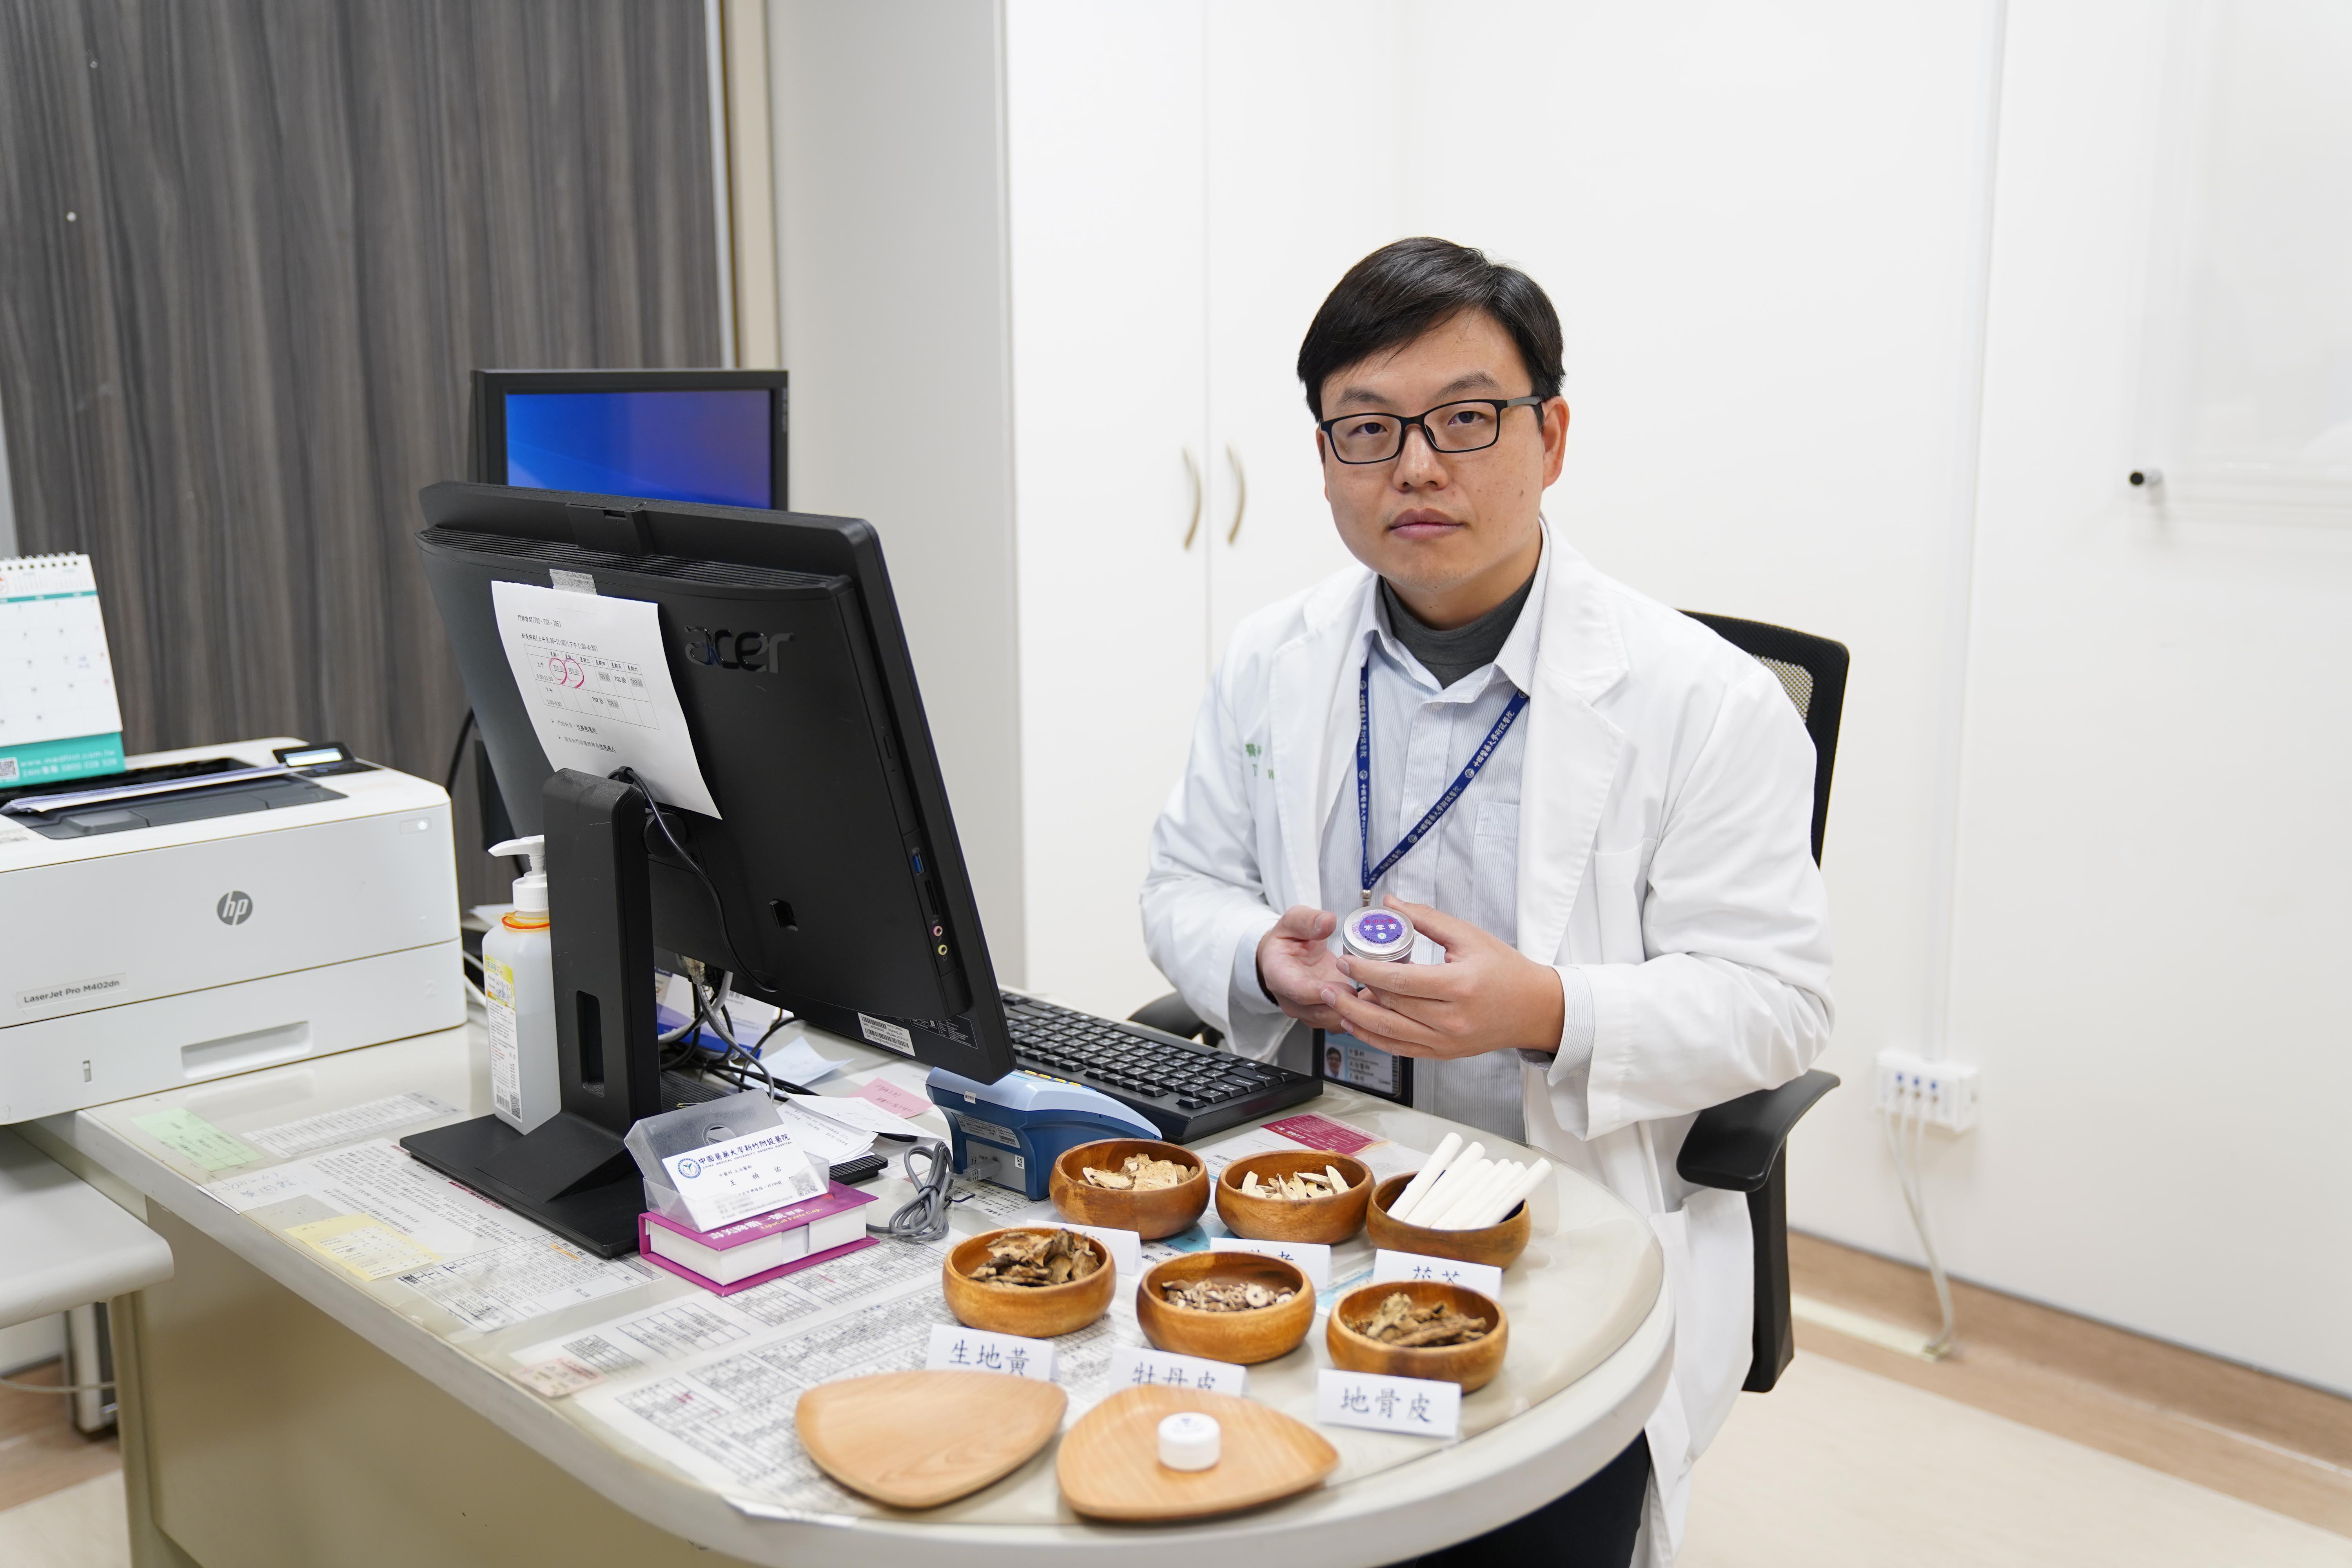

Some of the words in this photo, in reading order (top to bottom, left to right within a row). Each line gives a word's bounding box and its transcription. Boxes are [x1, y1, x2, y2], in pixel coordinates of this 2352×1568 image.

[685, 626, 795, 673] acer
[219, 890, 252, 926] hp
[24, 989, 63, 1004] LaserJet
[65, 987, 81, 996] Pro
[83, 979, 120, 993] M402dn
[699, 1134, 791, 1165] 中國醫藥大學新竹附設醫院
[734, 1152, 755, 1160] UNIVERSITY
[760, 1218, 788, 1230] LipoCol
[787, 1213, 806, 1221] Forte
[949, 1339, 1030, 1376] 生地黃
[1340, 1385, 1432, 1423] 地骨皮
